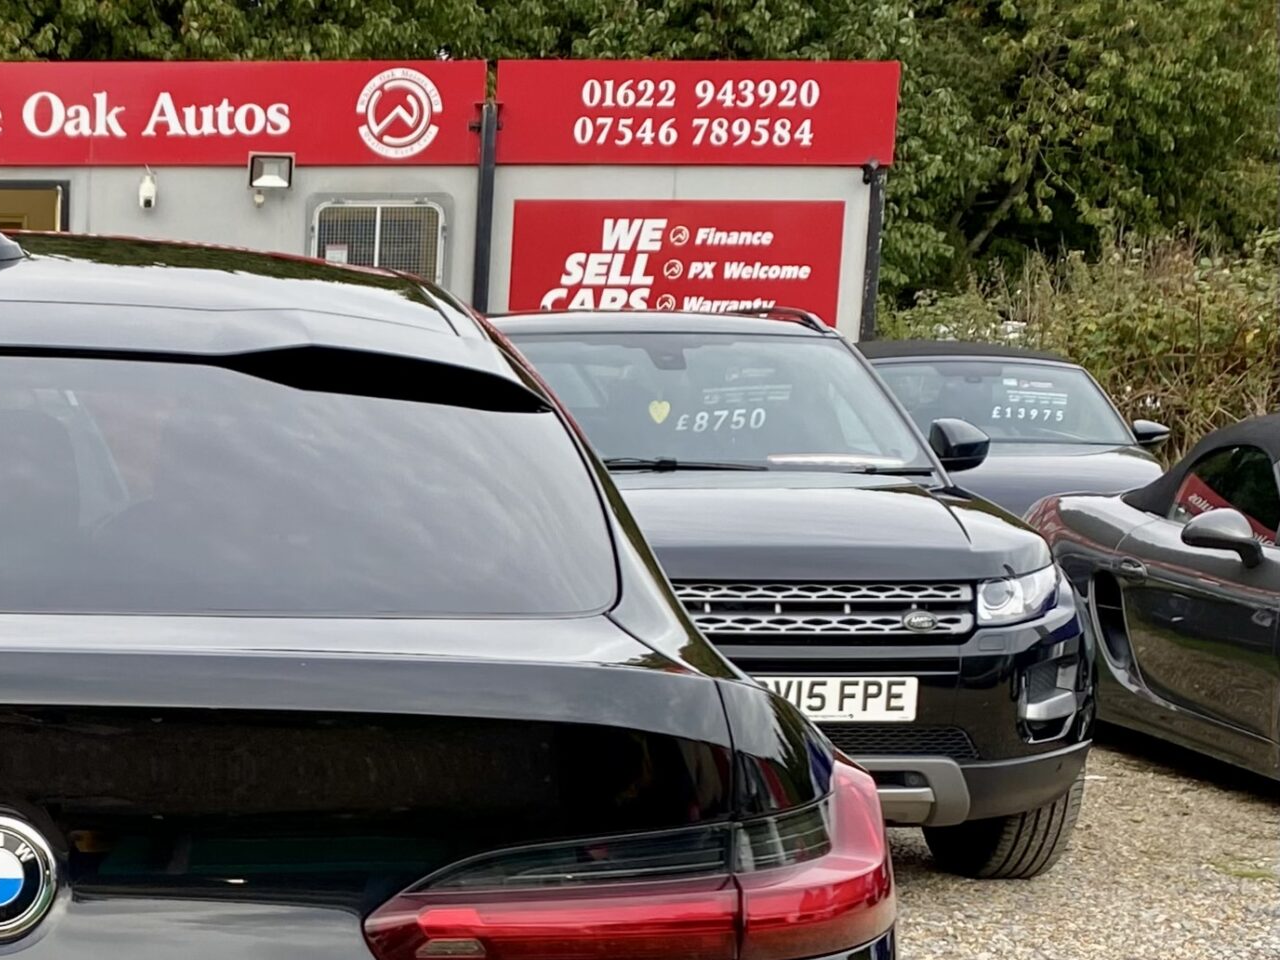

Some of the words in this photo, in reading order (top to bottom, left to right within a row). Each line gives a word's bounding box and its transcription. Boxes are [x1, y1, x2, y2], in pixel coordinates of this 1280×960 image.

[582, 79, 676, 108] 01622
[694, 79, 820, 108] 943920
[22, 91, 127, 137] Oak
[141, 91, 291, 137] Autos
[573, 117, 678, 146] 07546
[691, 117, 814, 147] 789584
[602, 218, 668, 252] WE
[695, 227, 774, 247] Finance
[560, 252, 654, 286] SELL
[687, 261, 717, 280] PX
[723, 261, 812, 281] Welcome
[540, 288, 652, 311] CARS
[682, 296, 777, 318] Warranty
[675, 407, 767, 433] £8750
[991, 405, 1065, 422] £13975
[759, 680, 828, 712] V15
[838, 680, 907, 712] FPE
